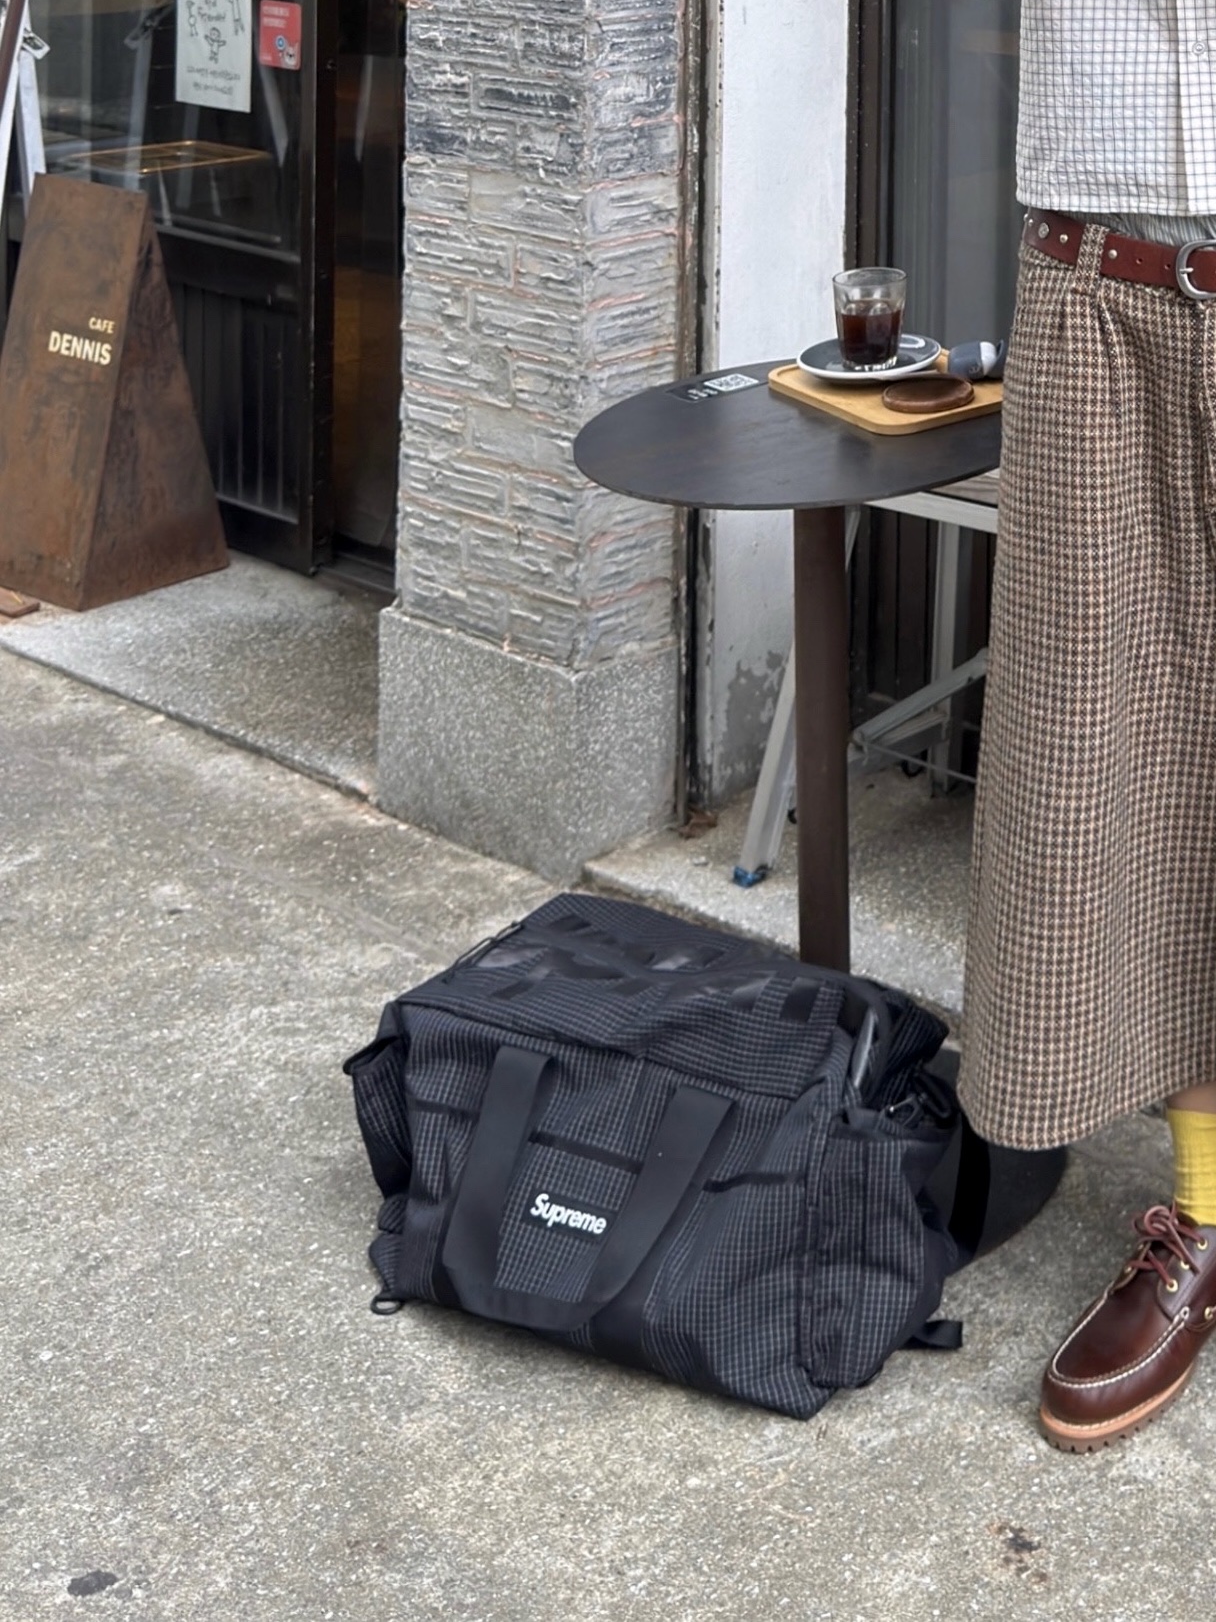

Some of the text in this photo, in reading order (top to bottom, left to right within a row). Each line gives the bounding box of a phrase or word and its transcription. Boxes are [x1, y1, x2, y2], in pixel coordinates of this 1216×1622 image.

[89, 316, 115, 334] CAFE
[48, 330, 113, 366] DENNIS
[530, 1193, 607, 1235] Supreme
